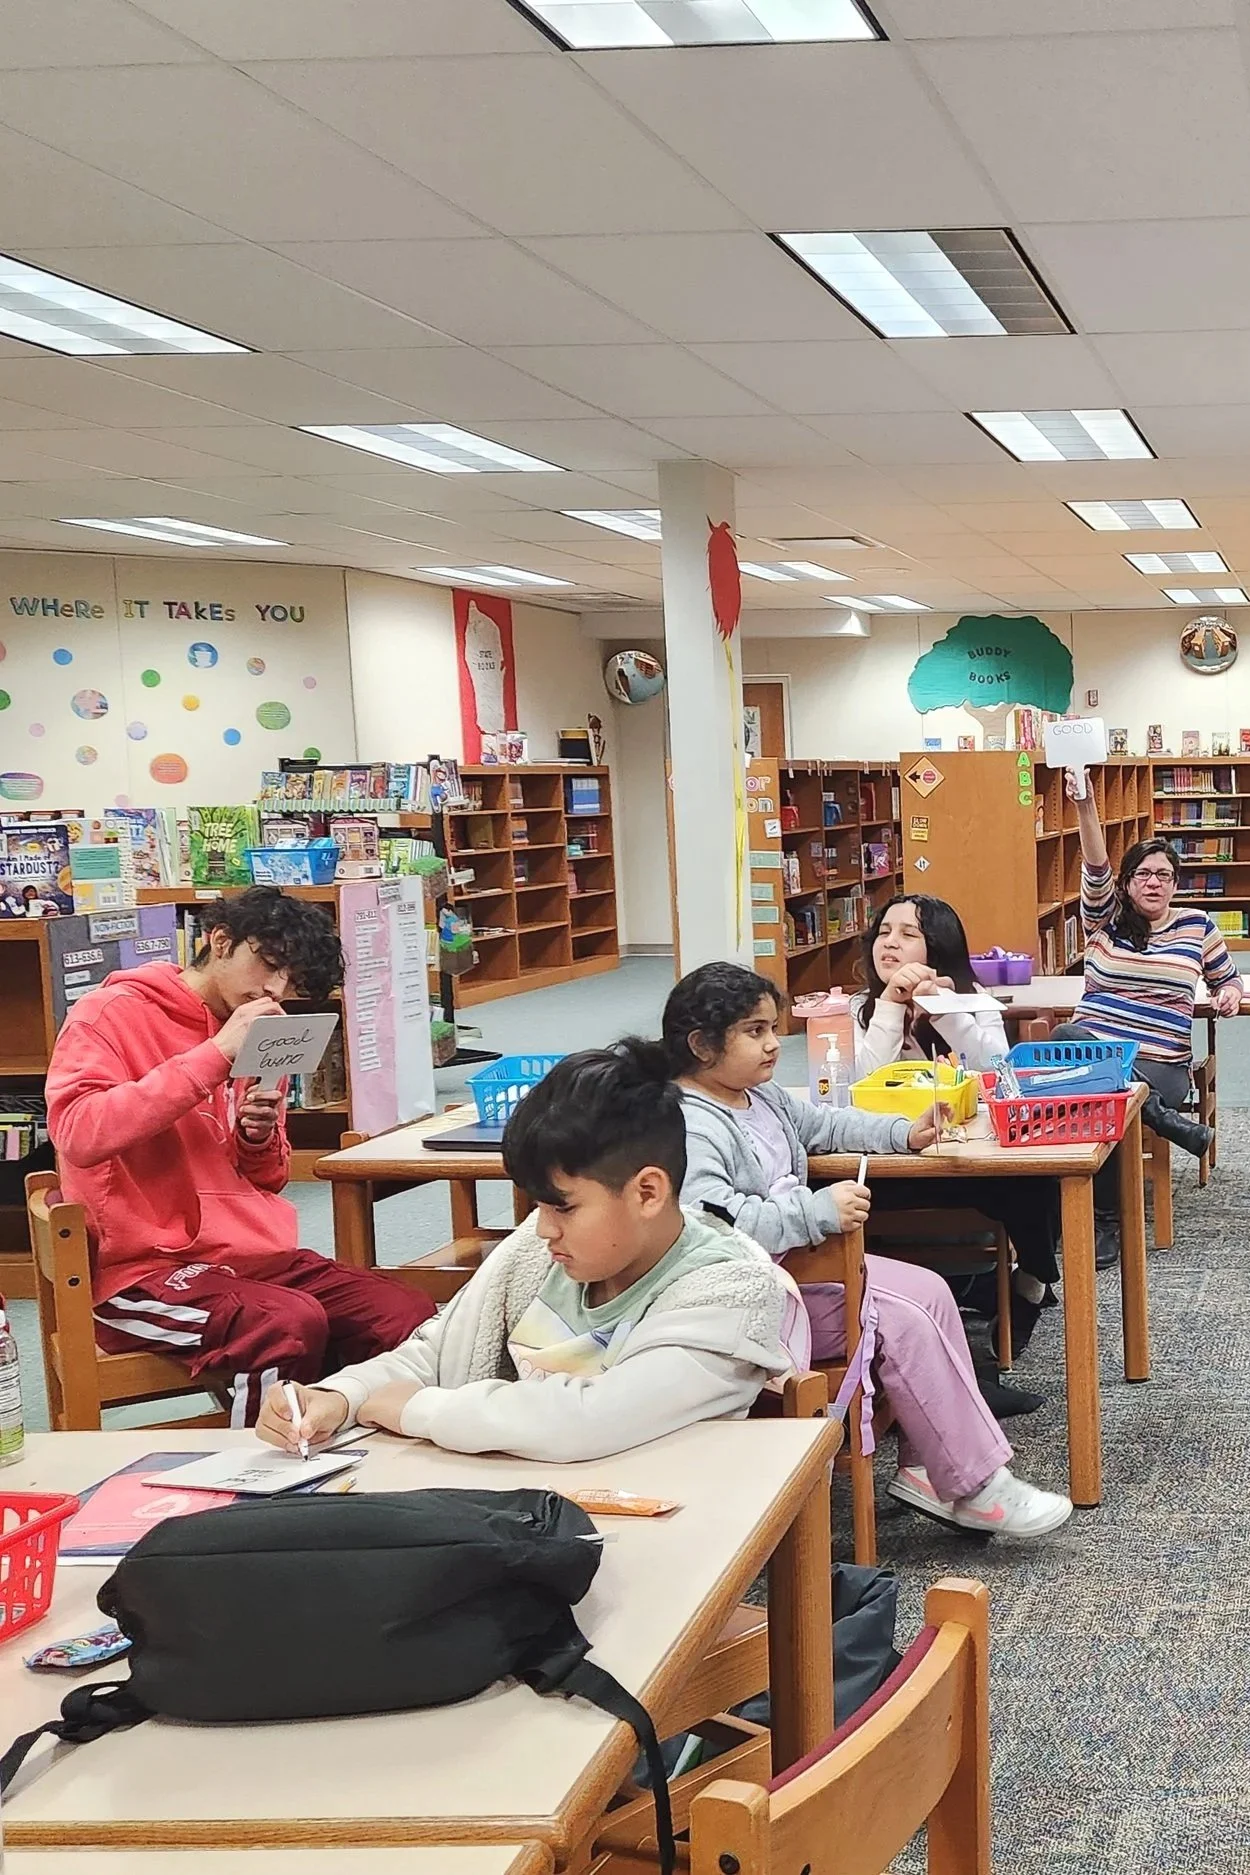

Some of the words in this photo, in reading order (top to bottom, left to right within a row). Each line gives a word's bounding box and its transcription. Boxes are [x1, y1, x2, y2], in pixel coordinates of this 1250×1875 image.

[123, 598, 149, 618] IT
[255, 603, 304, 623] YOU
[967, 646, 1012, 660] BUDDY
[969, 670, 1011, 684] BOOKS
[1053, 722, 1094, 736] GOOD
[204, 822, 234, 837] TREE
[203, 838, 238, 853] HOME
[257, 1029, 315, 1052] Good
